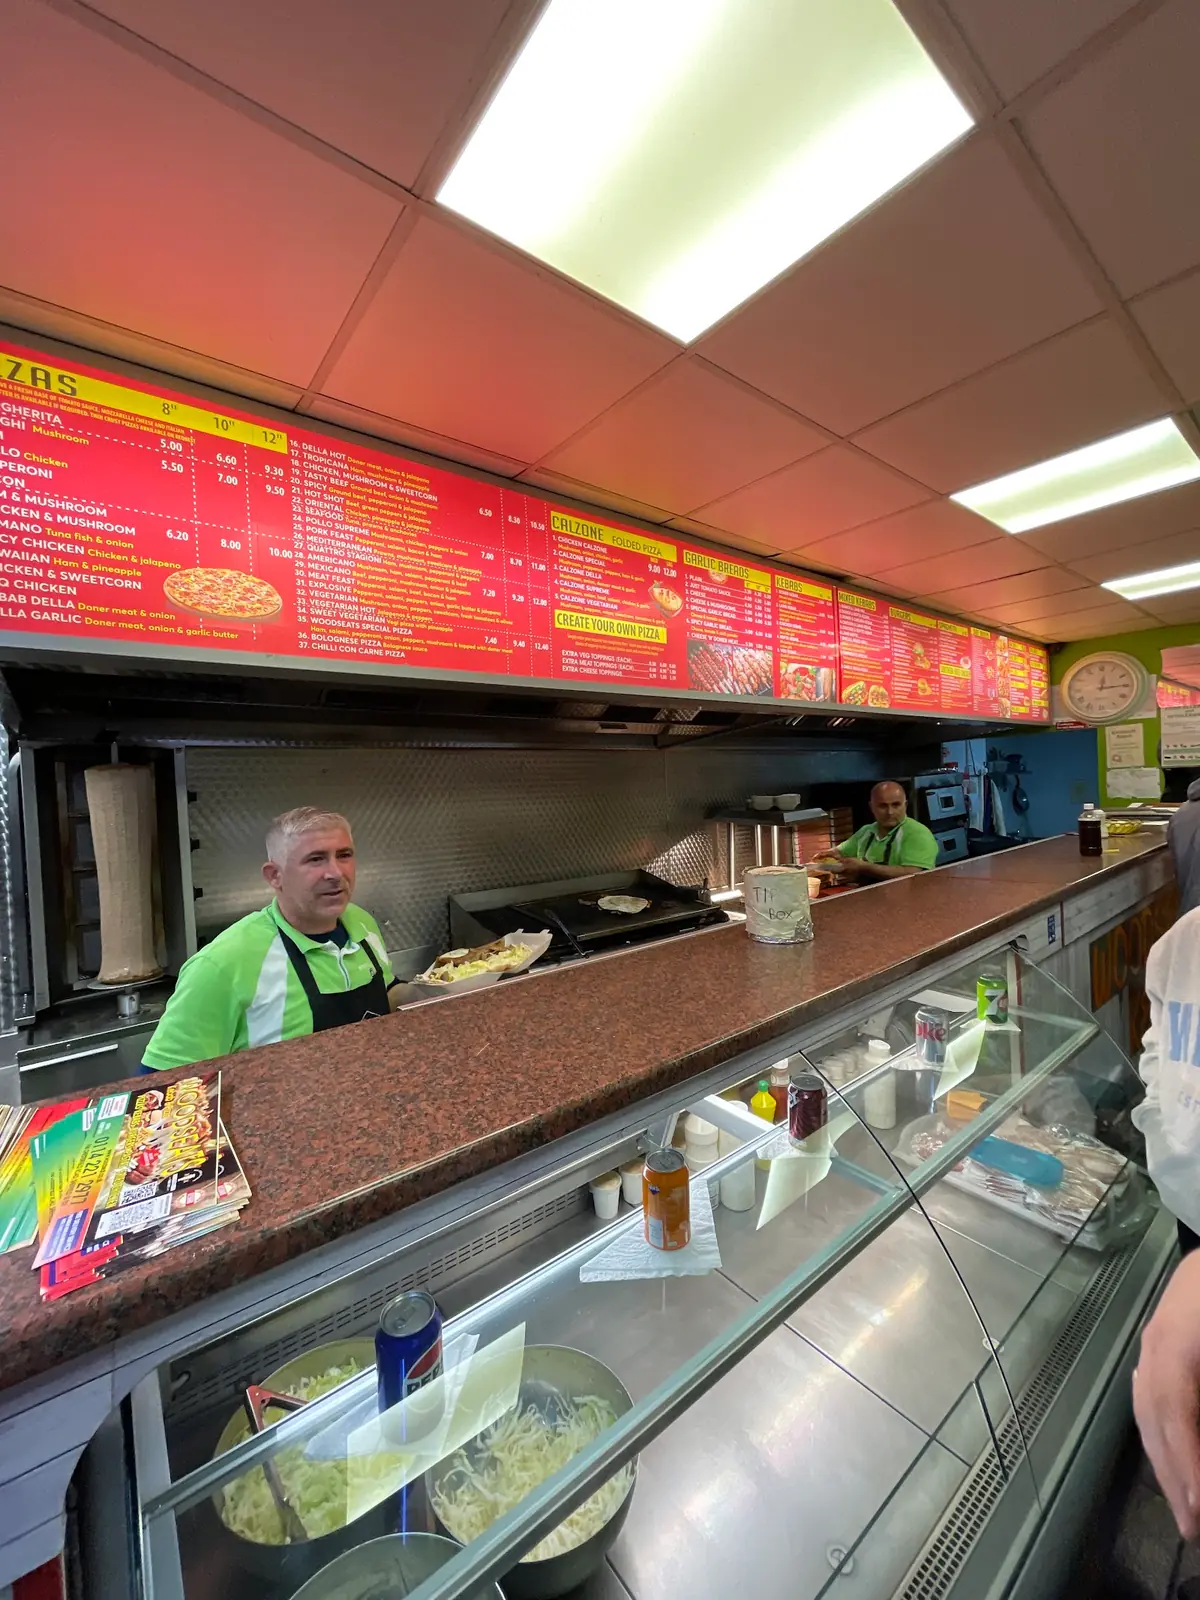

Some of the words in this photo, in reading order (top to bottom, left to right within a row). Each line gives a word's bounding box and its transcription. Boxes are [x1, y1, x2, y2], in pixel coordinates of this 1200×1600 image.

[0, 360, 77, 396] ZAS
[32, 425, 89, 445] Mushroom
[24, 452, 68, 468] Chicken
[160, 439, 182, 452] 5.00
[216, 453, 236, 465] 6.60
[264, 464, 284, 477] 9.30
[302, 443, 328, 455] DELLA
[330, 451, 346, 460] HOT
[303, 452, 349, 470] TROPICANA
[161, 460, 183, 473] 5.50
[217, 473, 237, 486] 7.00
[266, 485, 284, 496] 9.50
[304, 470, 328, 482] TASTY
[330, 478, 349, 488] BEEF
[304, 480, 327, 491] SPICY
[343, 472, 387, 489] MUSHROOM
[396, 486, 438, 502] SWEETCORN
[304, 489, 321, 499] HOT
[323, 494, 344, 503] SHOT
[25, 495, 107, 517] MUSHROOM
[305, 499, 344, 513] ORIENTAL
[305, 506, 344, 521] SEAFOOD
[44, 512, 52, 522] &
[57, 515, 135, 535] MUSHROOM
[306, 517, 332, 528] POLLO
[334, 523, 370, 536] SUPREME
[479, 508, 492, 517] 6.50
[508, 515, 520, 524] 8.30
[531, 521, 545, 531] 10.50
[45, 528, 71, 539] Tuna
[74, 532, 92, 542] fish
[106, 539, 134, 549] onion
[306, 525, 328, 536] PORK
[331, 531, 354, 540] FEAST
[552, 516, 604, 541] CALZONE
[612, 536, 641, 550] FOLDED
[643, 544, 662, 556] PIZZA
[166, 529, 189, 541] 6.20
[221, 539, 241, 551] 8.00
[269, 547, 292, 559] 10.00
[307, 535, 372, 553] MEDITERRANEAN
[22, 538, 84, 555] CHICKEN
[88, 549, 128, 562] Chicken
[140, 557, 181, 569] jalapeno
[307, 545, 345, 557] QUATTRO
[347, 551, 381, 563] STAGIONI
[307, 553, 355, 567] AMERICANO
[481, 551, 494, 561] 7.00
[510, 558, 522, 567] 8.70
[53, 558, 78, 568] Ham
[92, 564, 142, 577] pineapple
[308, 563, 351, 575] MEXICANO
[648, 564, 660, 574] 9.00
[663, 568, 677, 578] 12.00
[685, 552, 716, 570] GARLIC
[718, 561, 749, 579] BREADS
[47, 570, 56, 579] &
[60, 571, 142, 590] SWEETCORN
[308, 571, 329, 581] MEAT
[332, 575, 355, 585] FEAST
[308, 580, 352, 593] EXPLOSIVE
[776, 576, 802, 592] KEBABS
[14, 579, 77, 596] CHICKEN
[309, 590, 358, 603] VEGETARIAN
[310, 599, 358, 611] VEGETARIAN
[482, 589, 495, 597] 7.20
[512, 594, 524, 602] 9.20
[533, 598, 547, 607] 12.00
[31, 595, 75, 609] DELLA
[78, 602, 108, 613] Doner
[112, 607, 137, 616] meat
[150, 611, 175, 620] onion
[310, 608, 337, 617] SWEET
[339, 612, 386, 623] VEGETARIAN
[31, 610, 82, 624] GARLIC
[85, 617, 116, 628] Doner
[119, 622, 146, 631] meat,
[149, 624, 174, 633] onion
[186, 628, 211, 639] garlic
[213, 628, 239, 639] butter
[310, 616, 360, 629] WOODSEATS
[362, 622, 391, 633] SPECIAL
[393, 627, 413, 635] PIZZA
[557, 613, 589, 629] CREATE
[591, 618, 615, 633] YOUR
[617, 623, 636, 636] OWN
[638, 628, 660, 640] PIZZA
[311, 633, 358, 645] BOLOGNESE
[484, 636, 497, 645] 7.40
[513, 640, 525, 648] 9.40
[311, 643, 337, 651] CHILLI
[358, 648, 383, 656] CARNE
[89, 1136, 109, 1159] 0114
[81, 1160, 101, 1178] 221
[71, 1180, 93, 1204] 2977
